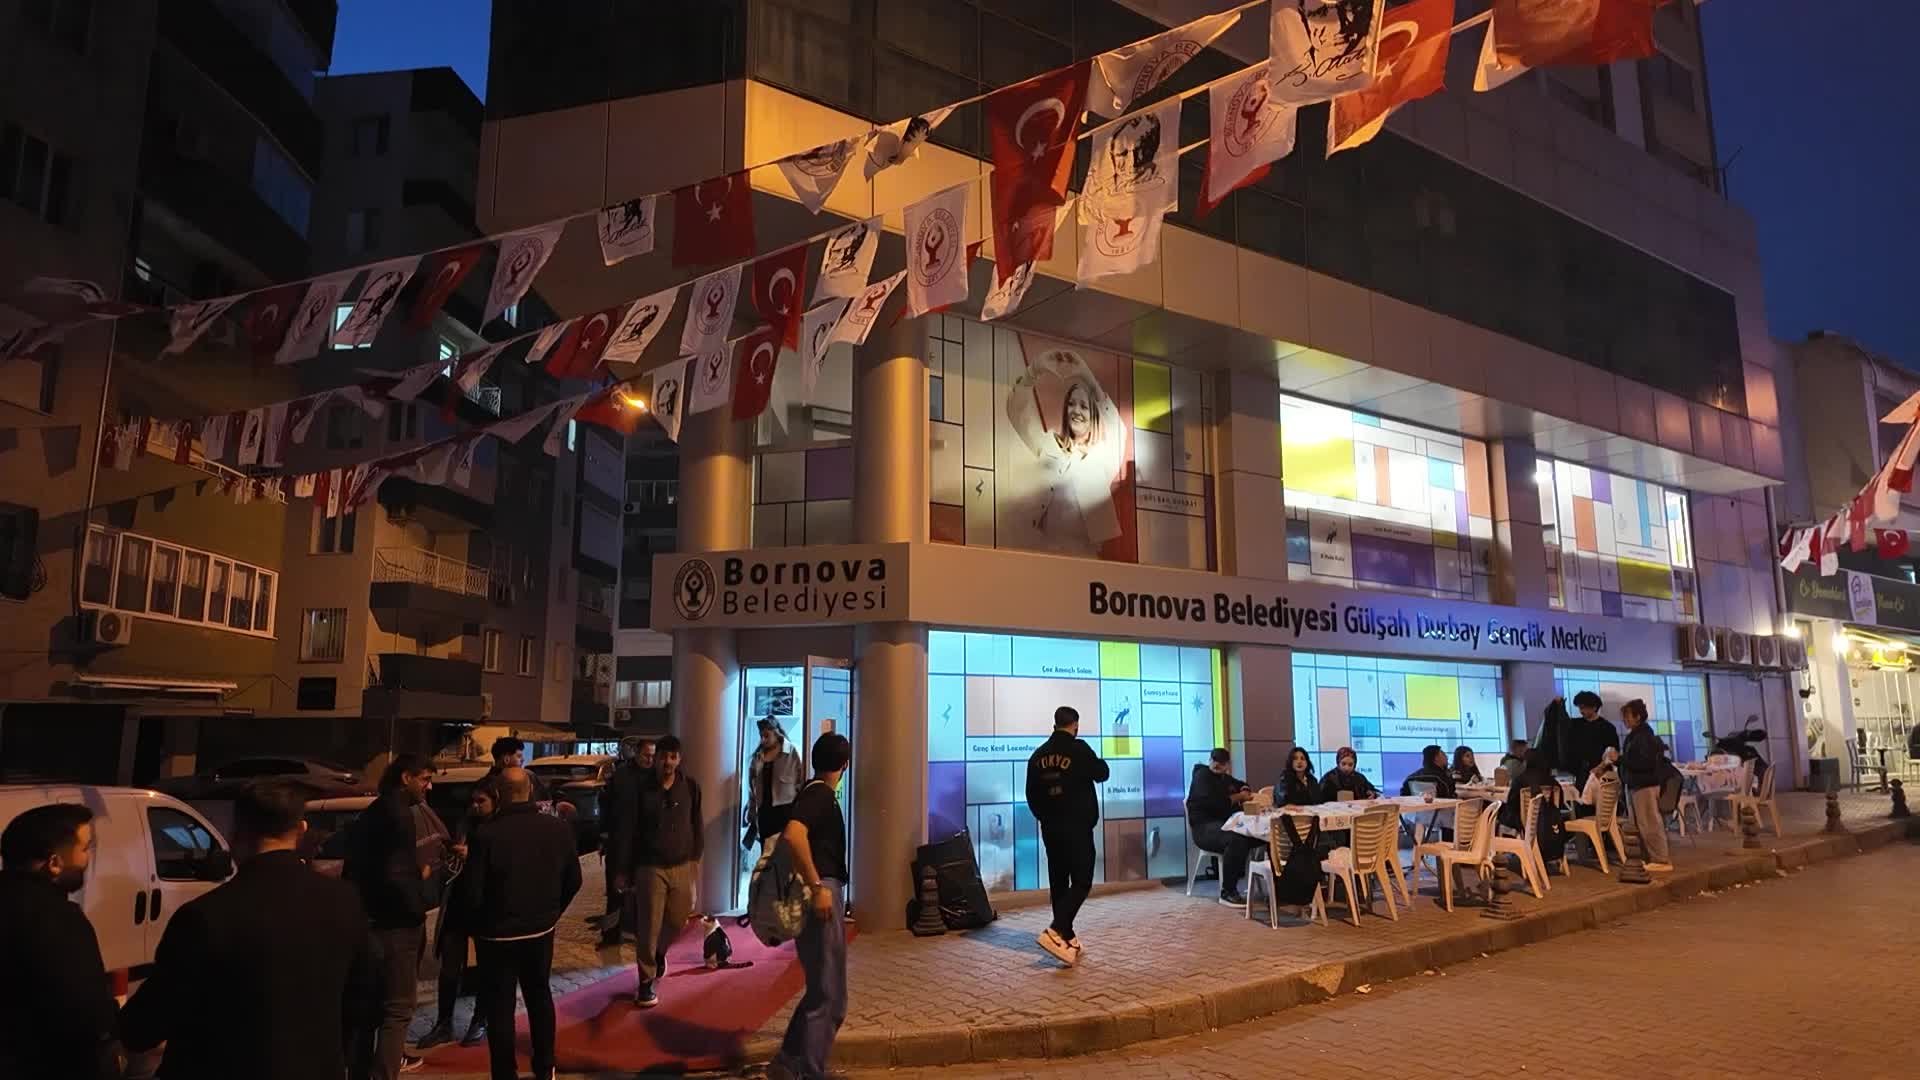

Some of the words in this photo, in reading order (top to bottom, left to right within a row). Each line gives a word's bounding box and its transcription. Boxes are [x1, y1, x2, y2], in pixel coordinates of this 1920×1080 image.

[724, 557, 887, 586] Bornova
[723, 586, 887, 618] Belediyesi
[1089, 581, 1206, 622] Bornova
[1213, 592, 1338, 638] Belediyesi
[1343, 605, 1411, 641] Gülşah
[1416, 610, 1481, 650] Durbay
[1487, 616, 1546, 652] Gençlik
[1551, 625, 1608, 653] Merkezi
